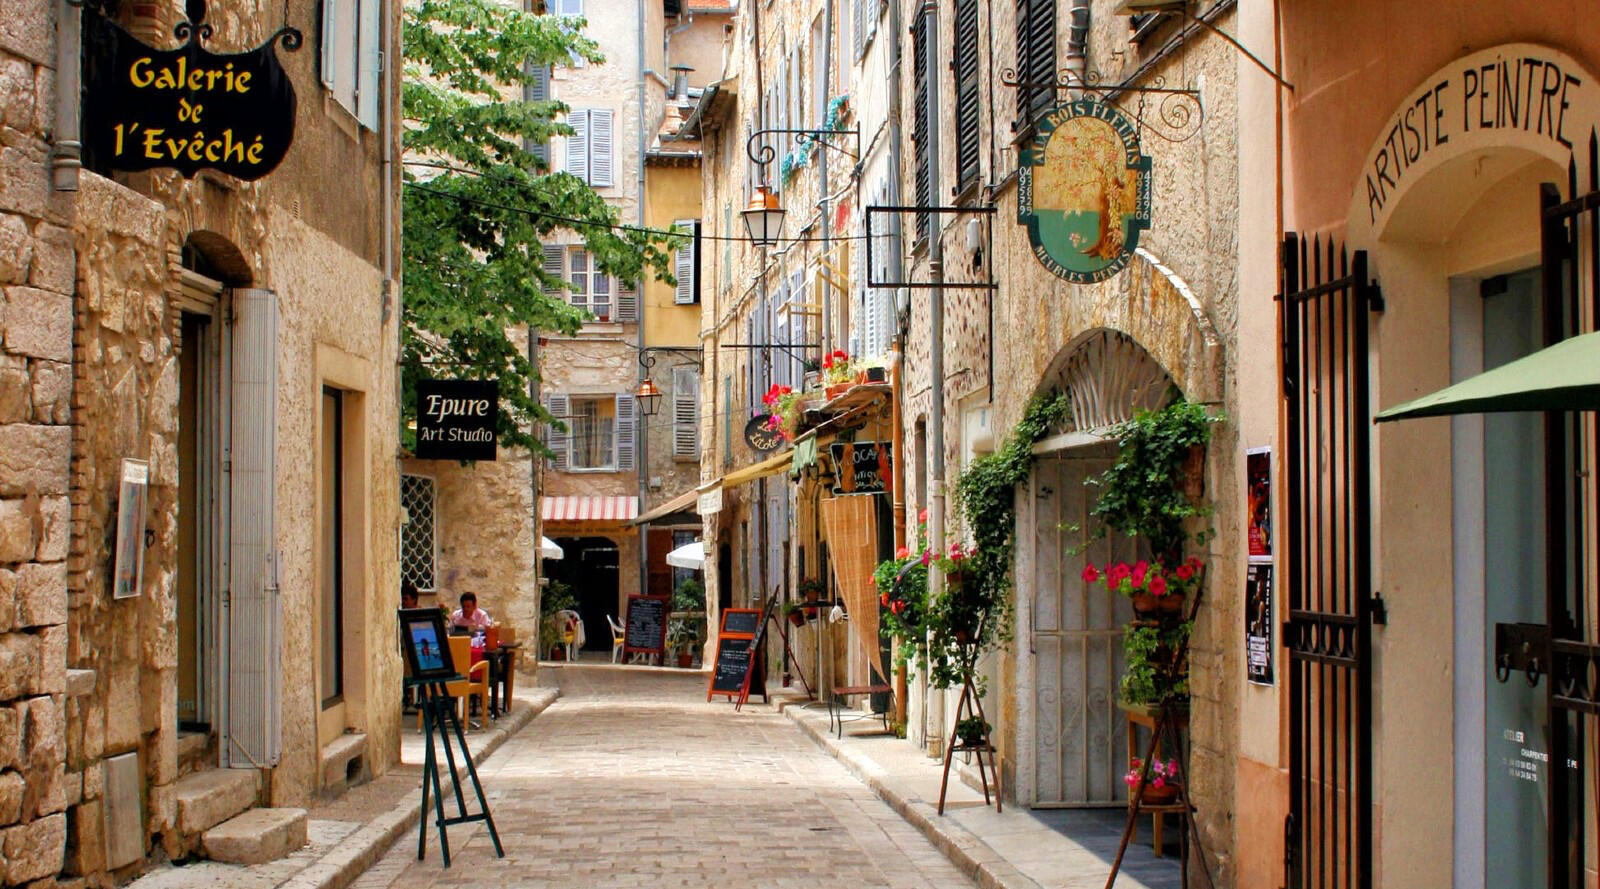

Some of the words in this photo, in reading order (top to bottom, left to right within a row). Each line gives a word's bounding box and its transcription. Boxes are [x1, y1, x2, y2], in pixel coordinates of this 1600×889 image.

[130, 56, 252, 93] Galerie
[178, 97, 203, 124] de
[114, 122, 264, 165] l'Evêché
[1032, 131, 1050, 164] AUX
[1047, 102, 1085, 128] BOIS
[1091, 102, 1140, 165] FLEURIS
[1366, 80, 1448, 226] ARTISTE
[1463, 54, 1581, 150] PEINTRE
[1019, 166, 1033, 176] 04
[1019, 176, 1033, 187] 93
[1136, 170, 1151, 181] 04
[1135, 190, 1150, 201] 24
[1135, 210, 1150, 220] 06
[1034, 244, 1086, 283] MEUBLES
[1092, 250, 1130, 282] PEINTS
[426, 394, 490, 424] Epure
[420, 426, 445, 441] Art
[448, 427, 493, 442] Studio
